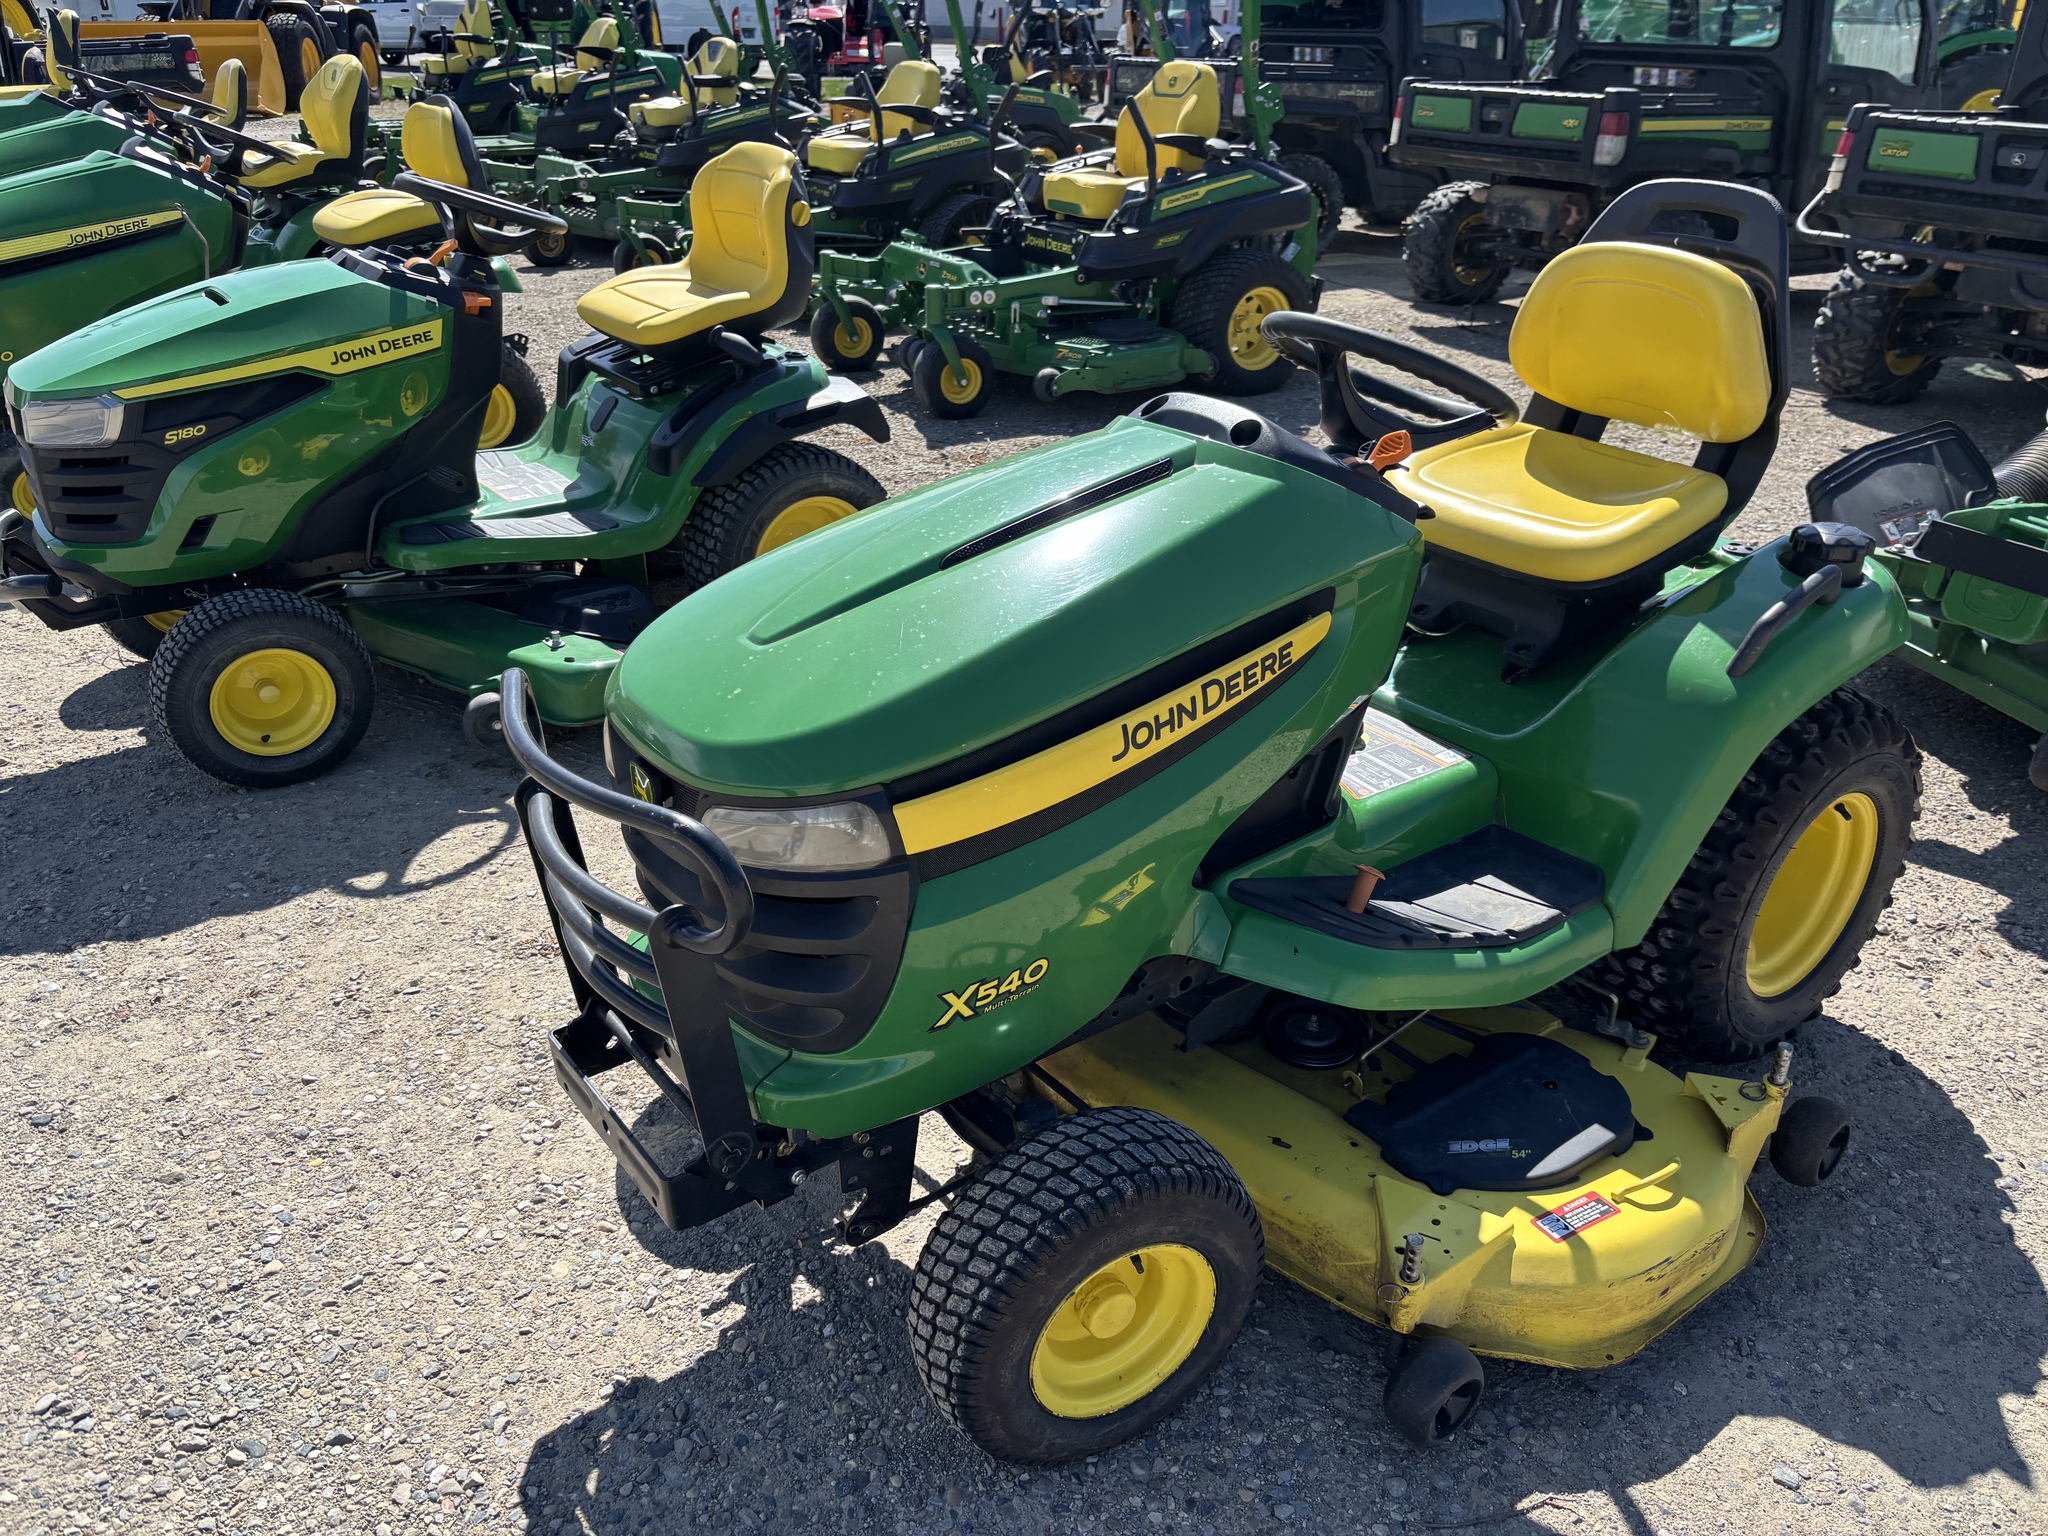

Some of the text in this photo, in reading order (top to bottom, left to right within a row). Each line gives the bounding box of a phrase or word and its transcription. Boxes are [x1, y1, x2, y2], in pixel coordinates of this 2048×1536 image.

[67, 218, 150, 247] JOHN DEERE
[1025, 233, 1073, 255] JOHN DEERE
[330, 330, 434, 366] JOHN DEERE
[164, 424, 207, 446] S180
[1112, 640, 1294, 763] JOHN DEERE
[928, 957, 1050, 1032] X540
[983, 984, 1040, 1014] Multi-Terrain
[1447, 1138, 1510, 1154] EDGE
